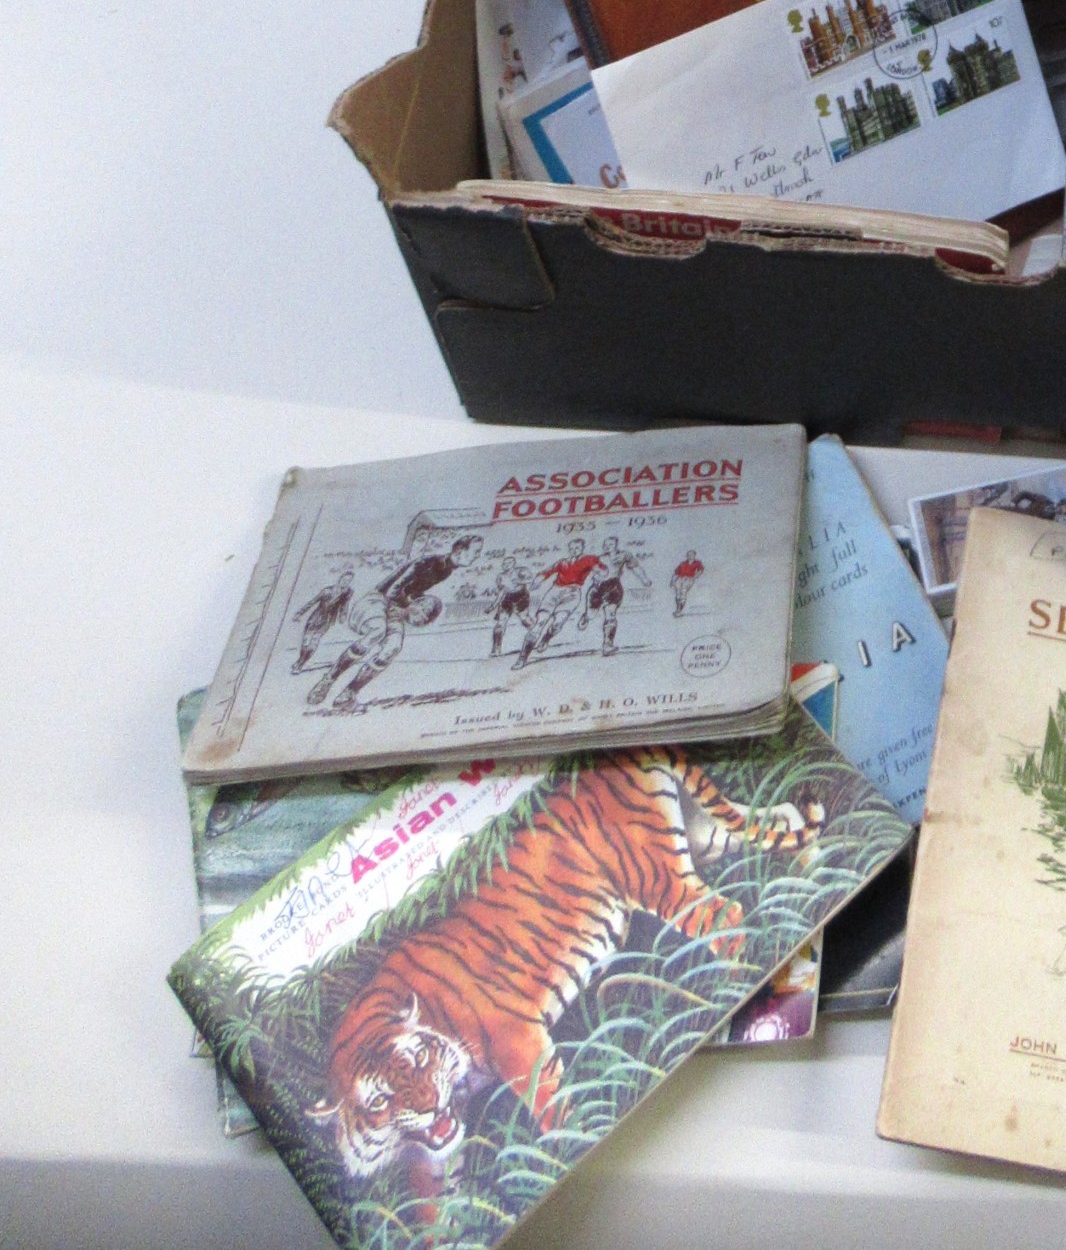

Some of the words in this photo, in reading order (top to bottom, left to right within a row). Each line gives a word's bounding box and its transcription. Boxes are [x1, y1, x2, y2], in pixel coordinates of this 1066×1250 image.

[497, 459, 743, 494] ASSOCIATION
[492, 483, 740, 520] FOOTBALLERS
[555, 521, 596, 534] 1935
[626, 515, 668, 527] 1936
[831, 562, 868, 590] cards
[454, 712, 500, 725] Issued
[508, 710, 525, 721] by
[646, 692, 698, 705] WILLS
[351, 791, 457, 885] Asian
[1010, 1036, 1057, 1054] JOHN
